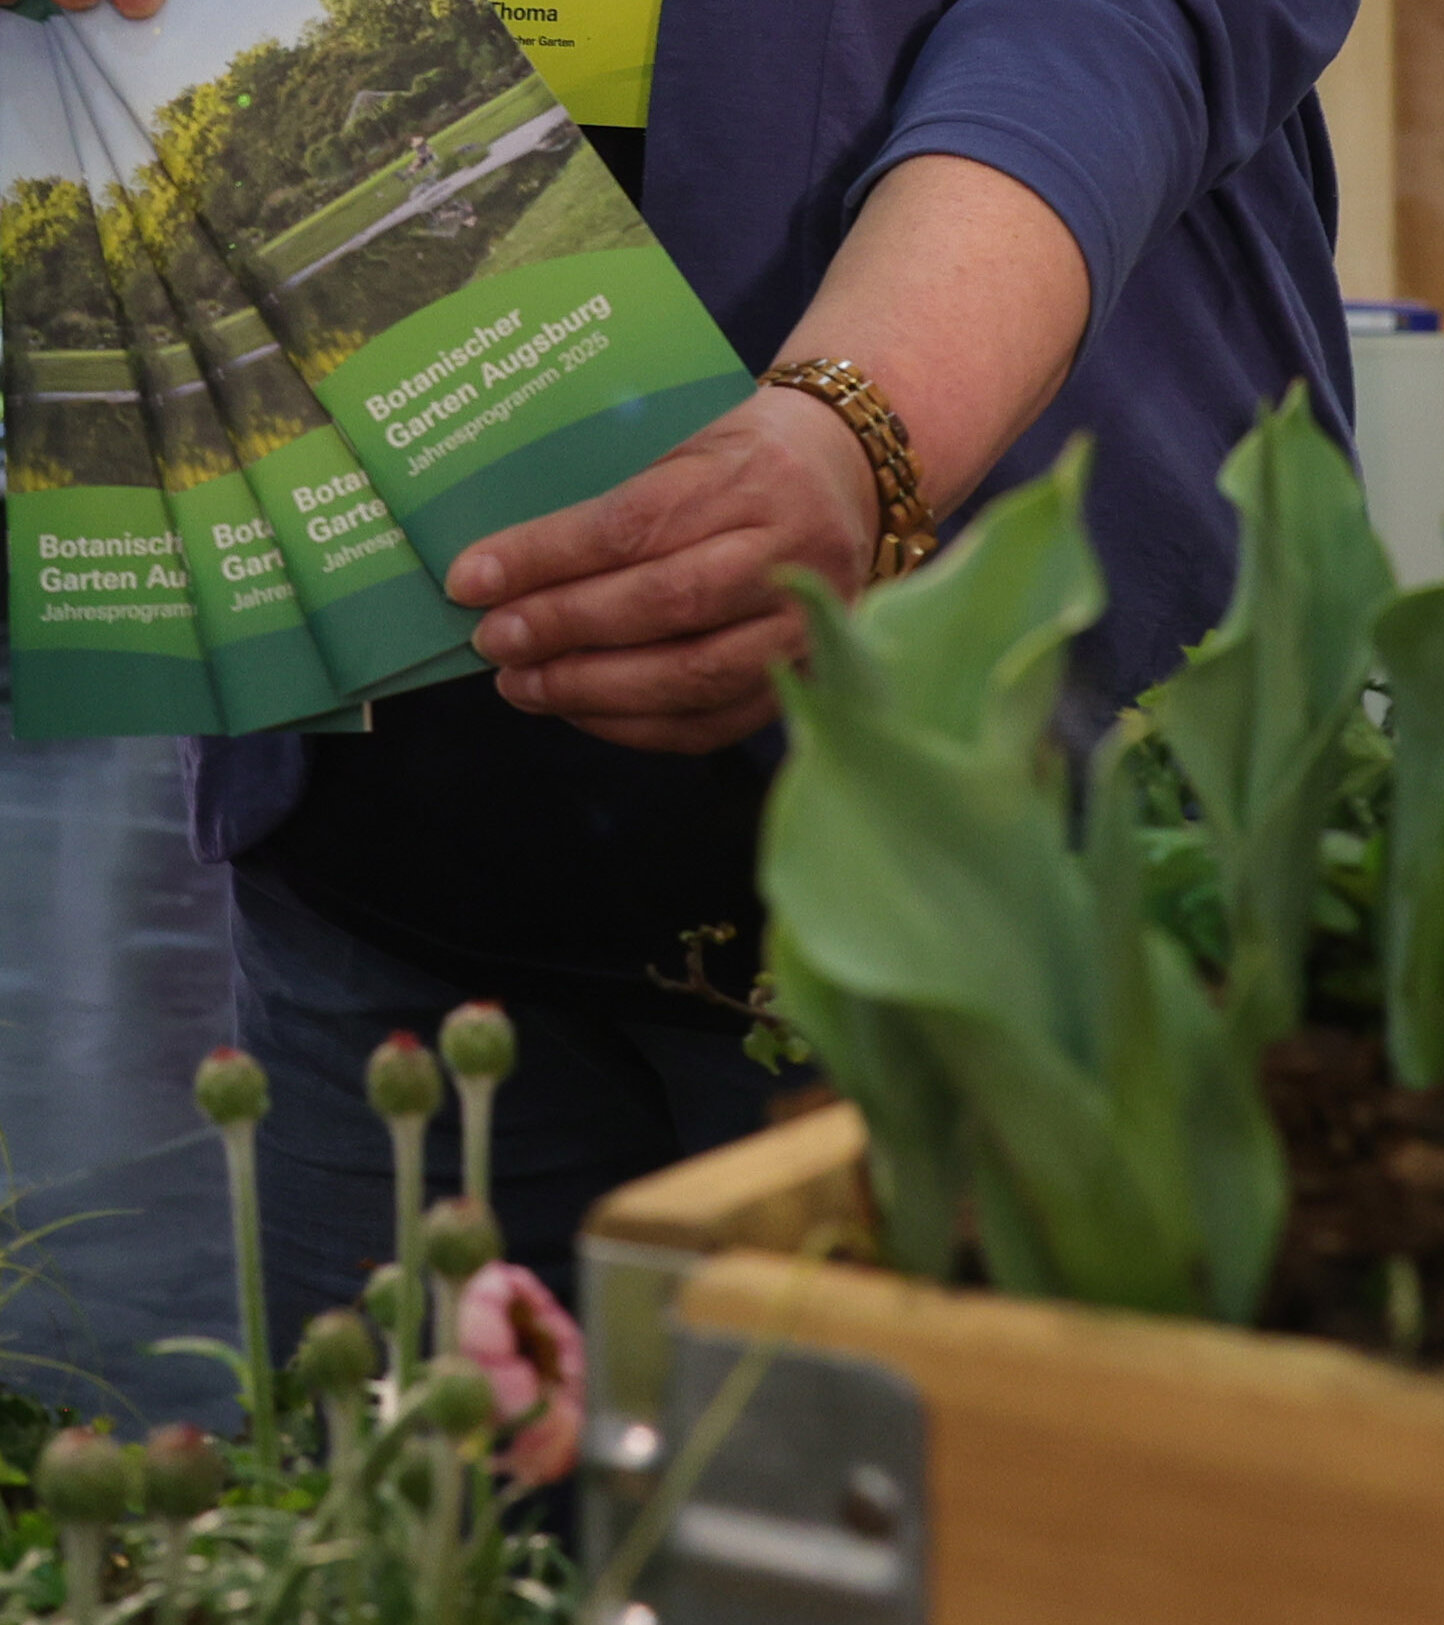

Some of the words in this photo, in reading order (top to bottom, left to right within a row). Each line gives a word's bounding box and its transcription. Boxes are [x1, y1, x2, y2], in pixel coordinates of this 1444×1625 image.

[539, 36, 575, 48] Garten
[365, 308, 523, 422] Botanischer
[385, 381, 480, 449] Garten
[481, 293, 612, 389] Augsburg
[408, 367, 561, 477] Jahresprogramm
[558, 330, 610, 373] 2025
[306, 498, 388, 544] Garte
[38, 530, 184, 560] Botanisch
[39, 566, 138, 593] Garten
